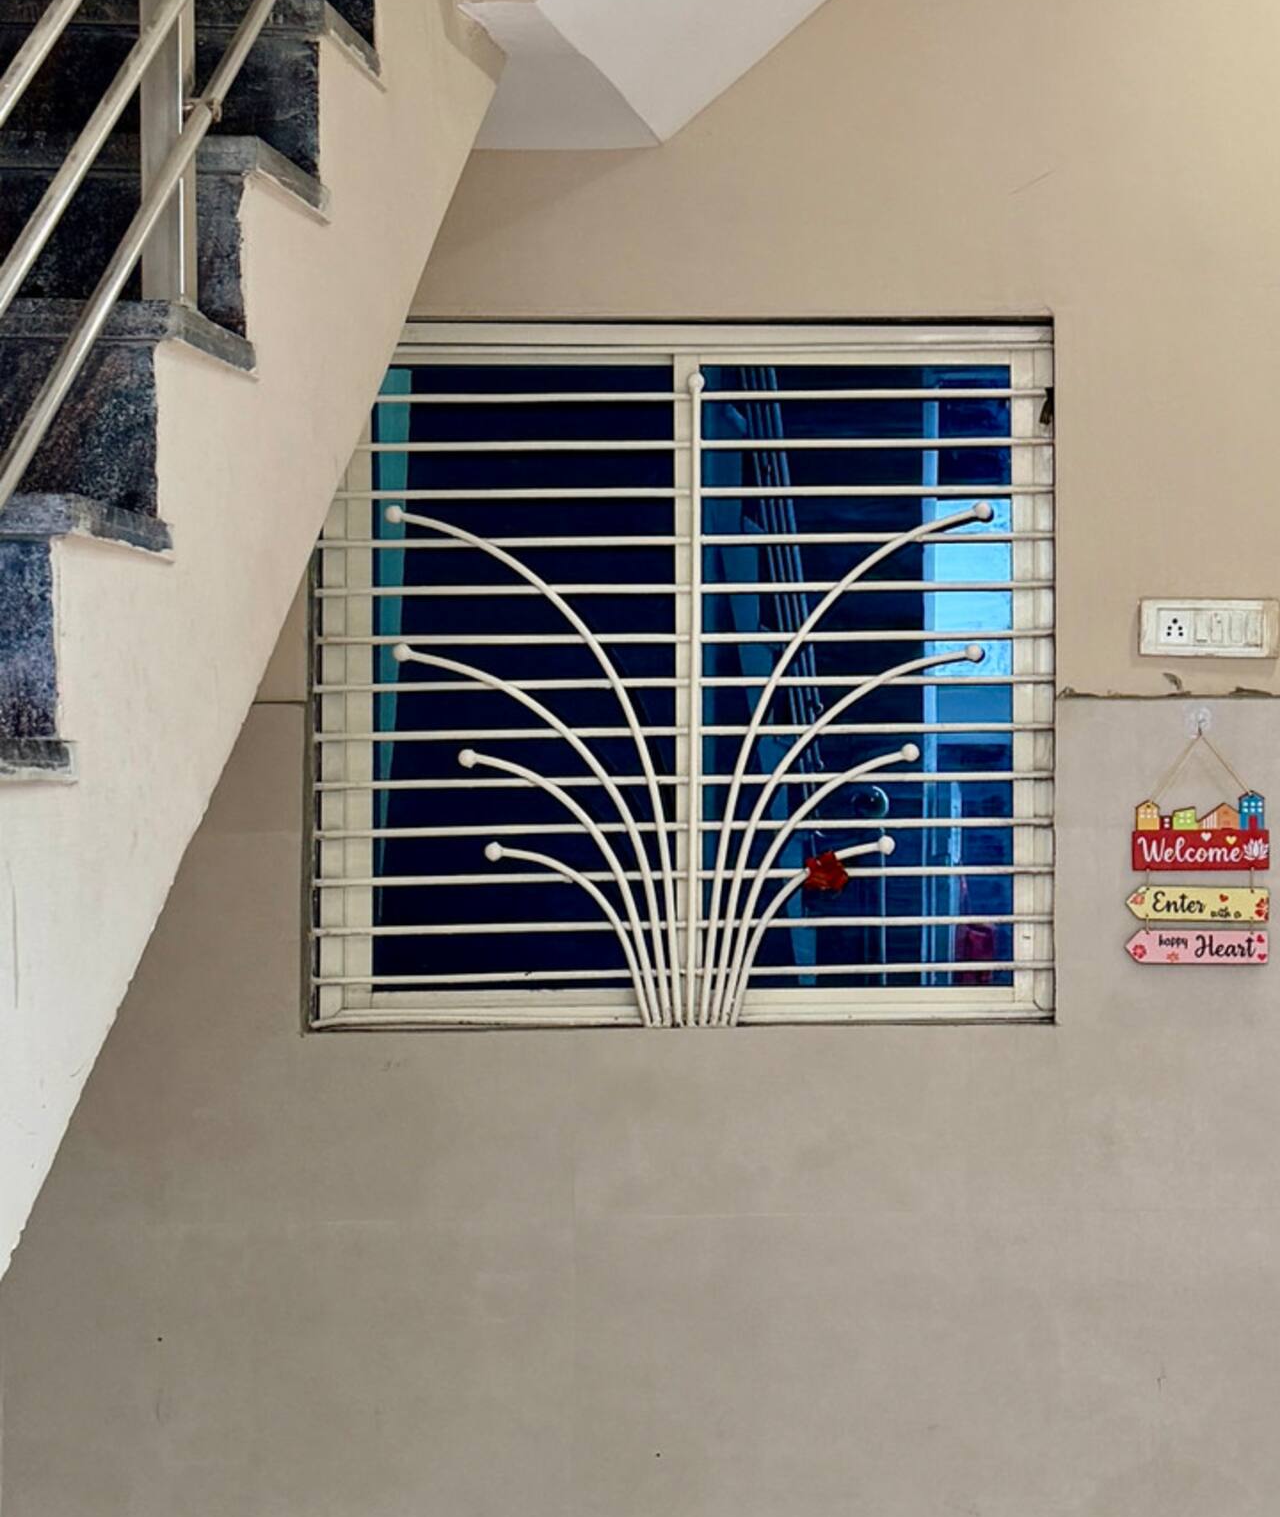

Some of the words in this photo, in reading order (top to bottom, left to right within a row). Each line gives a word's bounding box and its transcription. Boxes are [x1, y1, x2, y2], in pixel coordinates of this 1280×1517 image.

[1137, 836, 1242, 864] Welcome
[1152, 891, 1206, 914] Enter
[1210, 906, 1231, 919] with
[1158, 934, 1188, 949] happy
[1194, 933, 1256, 959] Heart
